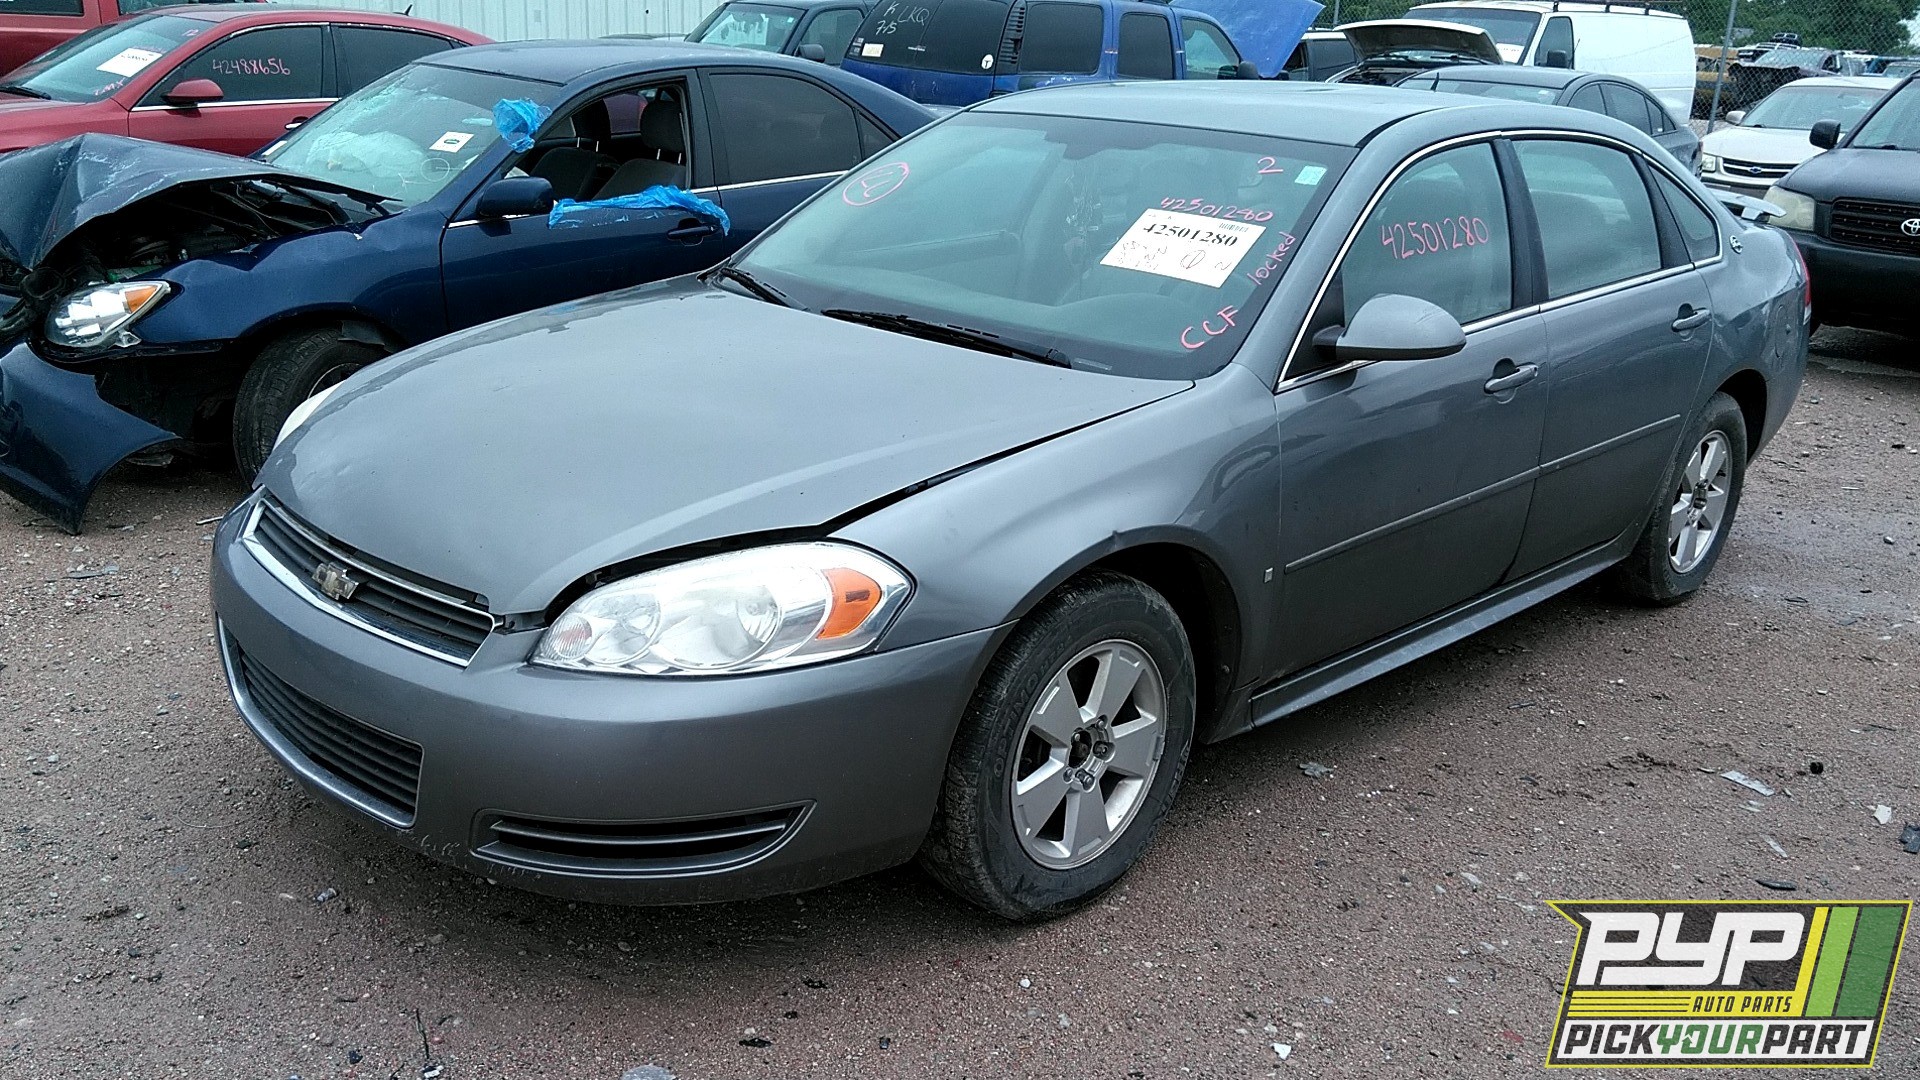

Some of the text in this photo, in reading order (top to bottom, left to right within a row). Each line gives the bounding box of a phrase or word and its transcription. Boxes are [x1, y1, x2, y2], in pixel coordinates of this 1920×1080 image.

[897, 6, 930, 26] LKQ
[212, 57, 291, 75] 42488656
[1257, 156, 1284, 174] 2
[1160, 197, 1275, 223] 42501280
[1143, 223, 1238, 247] 42501280
[1380, 216, 1489, 259] 42501280
[1246, 231, 1297, 286] locked
